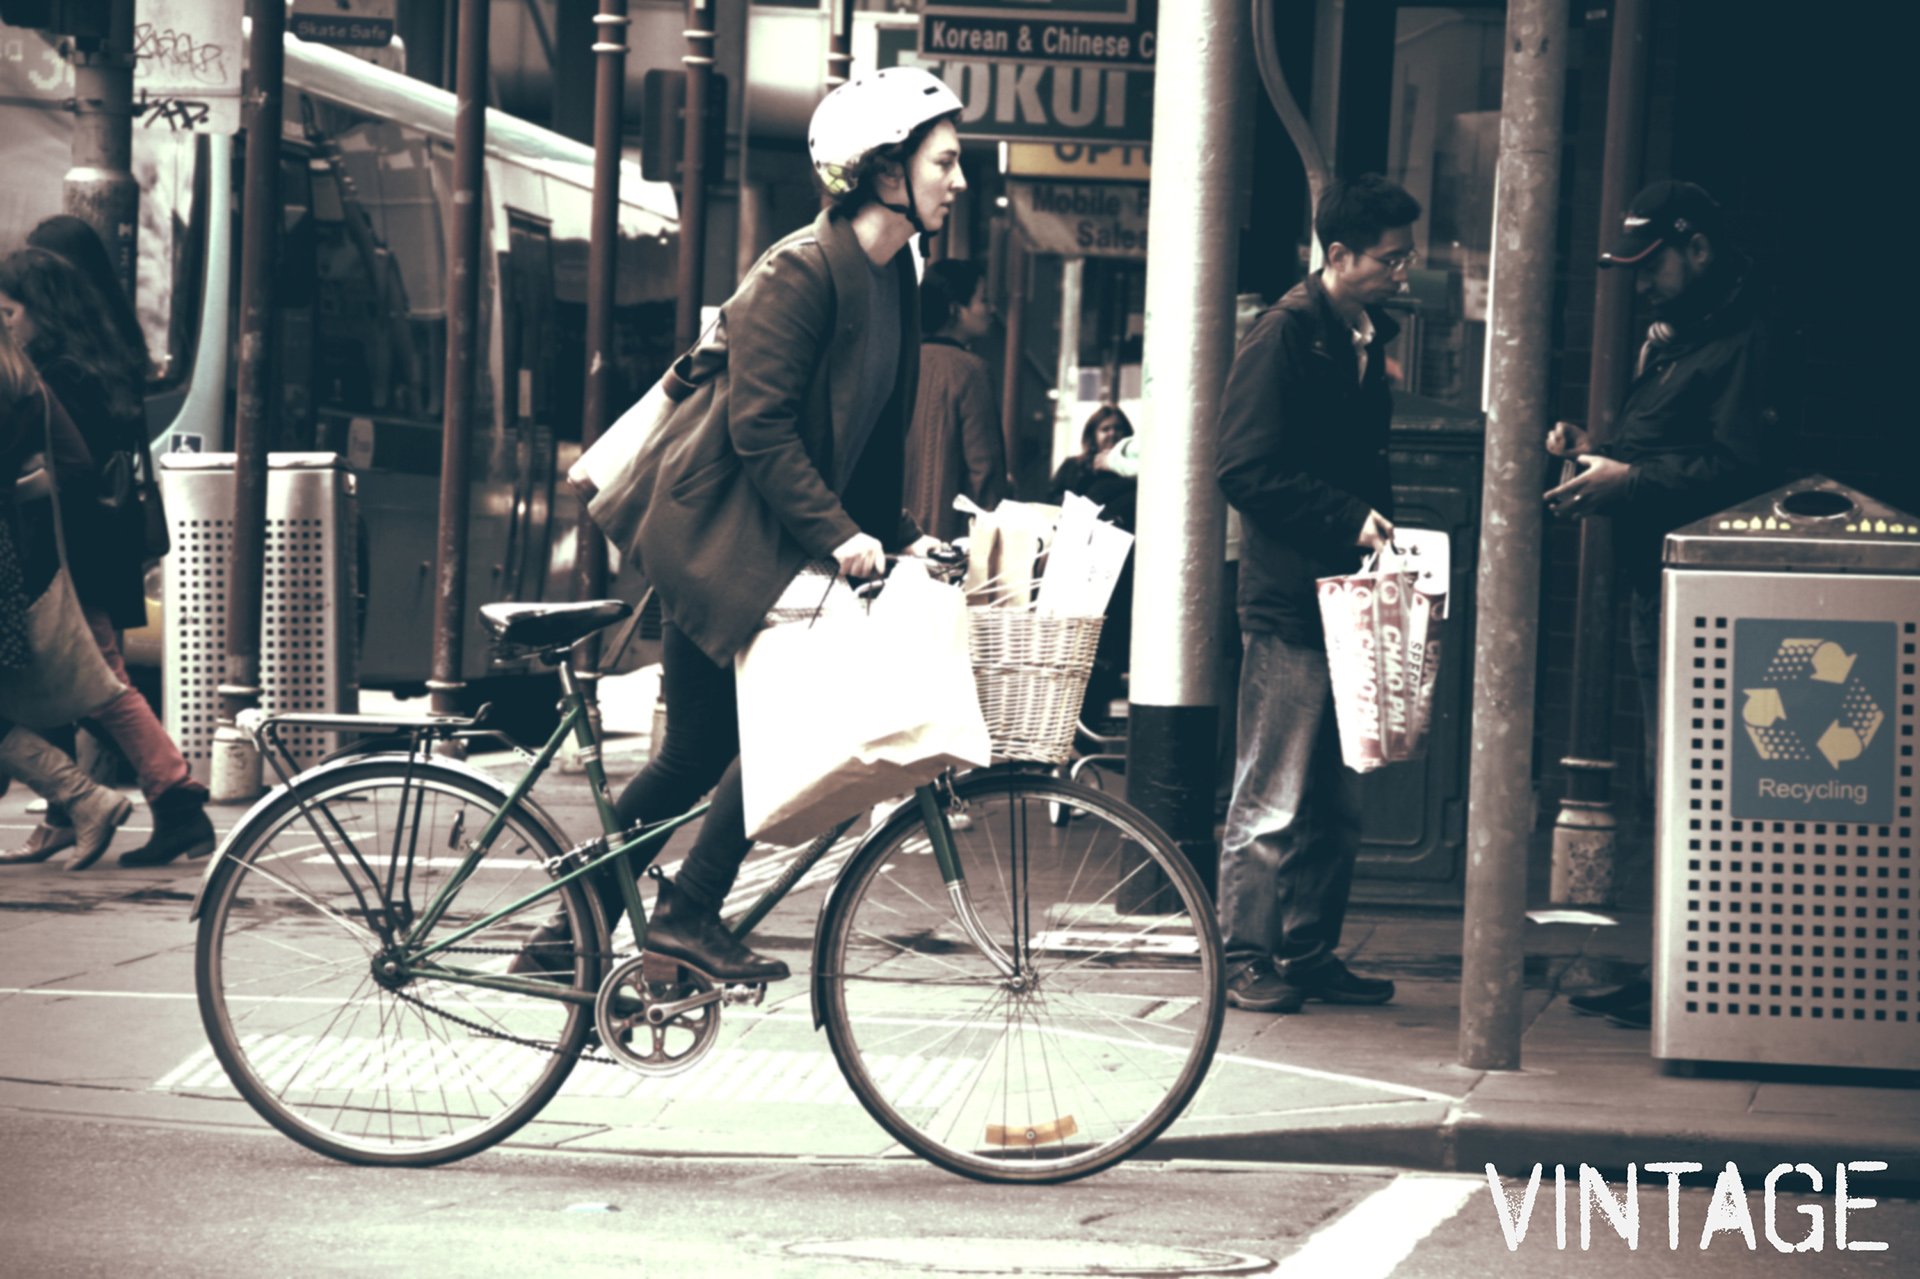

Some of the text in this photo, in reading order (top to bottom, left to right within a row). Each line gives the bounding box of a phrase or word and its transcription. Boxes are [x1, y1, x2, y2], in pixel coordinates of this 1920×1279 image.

[932, 21, 1008, 50] Korean
[1017, 25, 1032, 51] &
[1043, 26, 1129, 57] Chinese
[1382, 624, 1403, 691] CHAO
[1758, 778, 1868, 805] Recycling
